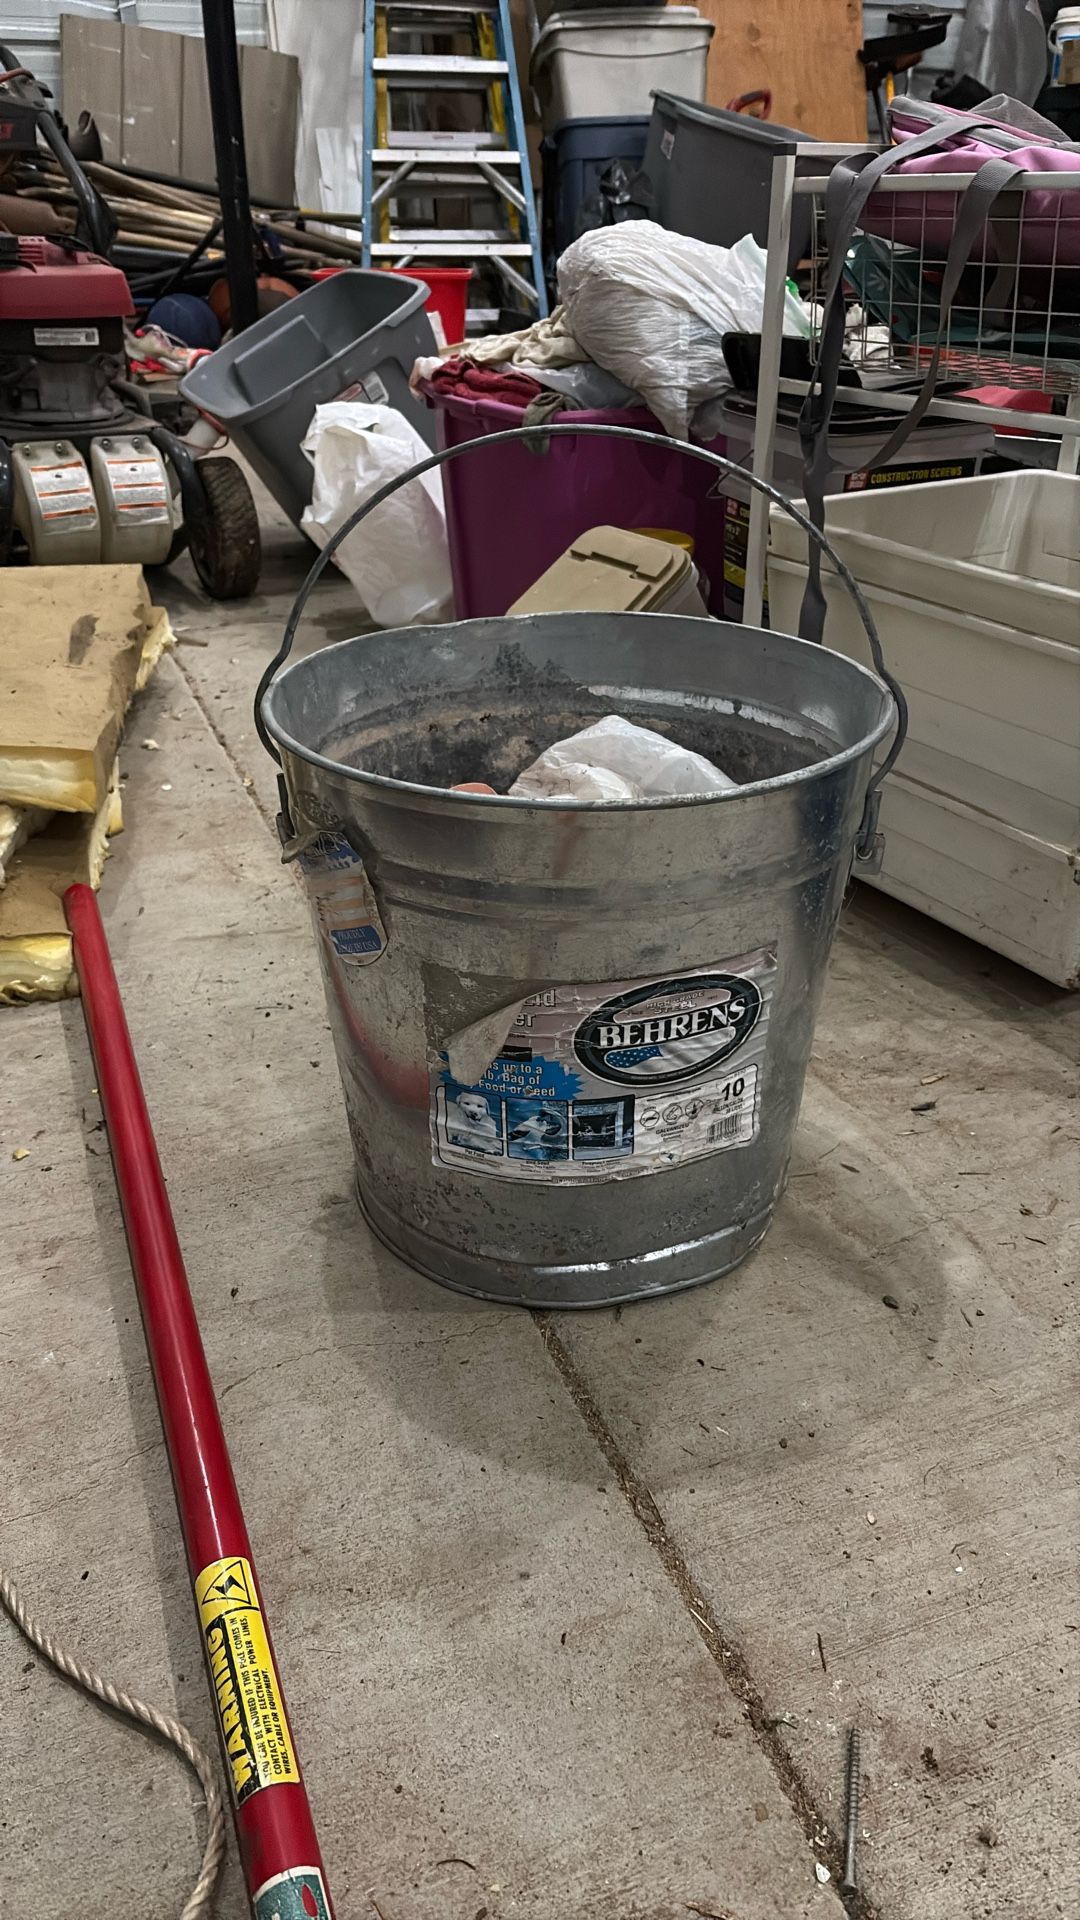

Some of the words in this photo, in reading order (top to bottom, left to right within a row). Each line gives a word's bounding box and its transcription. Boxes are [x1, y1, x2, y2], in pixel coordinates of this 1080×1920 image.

[871, 470, 929, 484] CONSTRUCTION
[930, 466, 962, 478] SCREWS
[596, 998, 746, 1049] BEHRENS
[502, 1072, 525, 1085] Bag
[528, 1075, 541, 1085] of
[520, 1063, 531, 1073] to
[535, 1065, 543, 1074] a
[477, 1079, 507, 1093] Food
[510, 1085, 521, 1094] or
[524, 1084, 556, 1097] Seed
[721, 1077, 746, 1101] 10
[229, 1616, 238, 1626] IN
[239, 1615, 251, 1637] LINES,
[232, 1627, 243, 1650] COMES
[245, 1640, 257, 1665] POWER
[241, 1670, 252, 1688] THIS
[252, 1669, 268, 1710] ELECTRICAL
[244, 1688, 254, 1697] IF
[207, 1627, 253, 1794] WARNING
[247, 1697, 261, 1729] INJURED
[271, 1712, 280, 1723] OR
[254, 1729, 264, 1741] BE
[262, 1714, 273, 1735] WITH
[274, 1723, 285, 1747] CABLE
[267, 1739, 282, 1775] CONTACT
[261, 1760, 272, 1779] YOU
